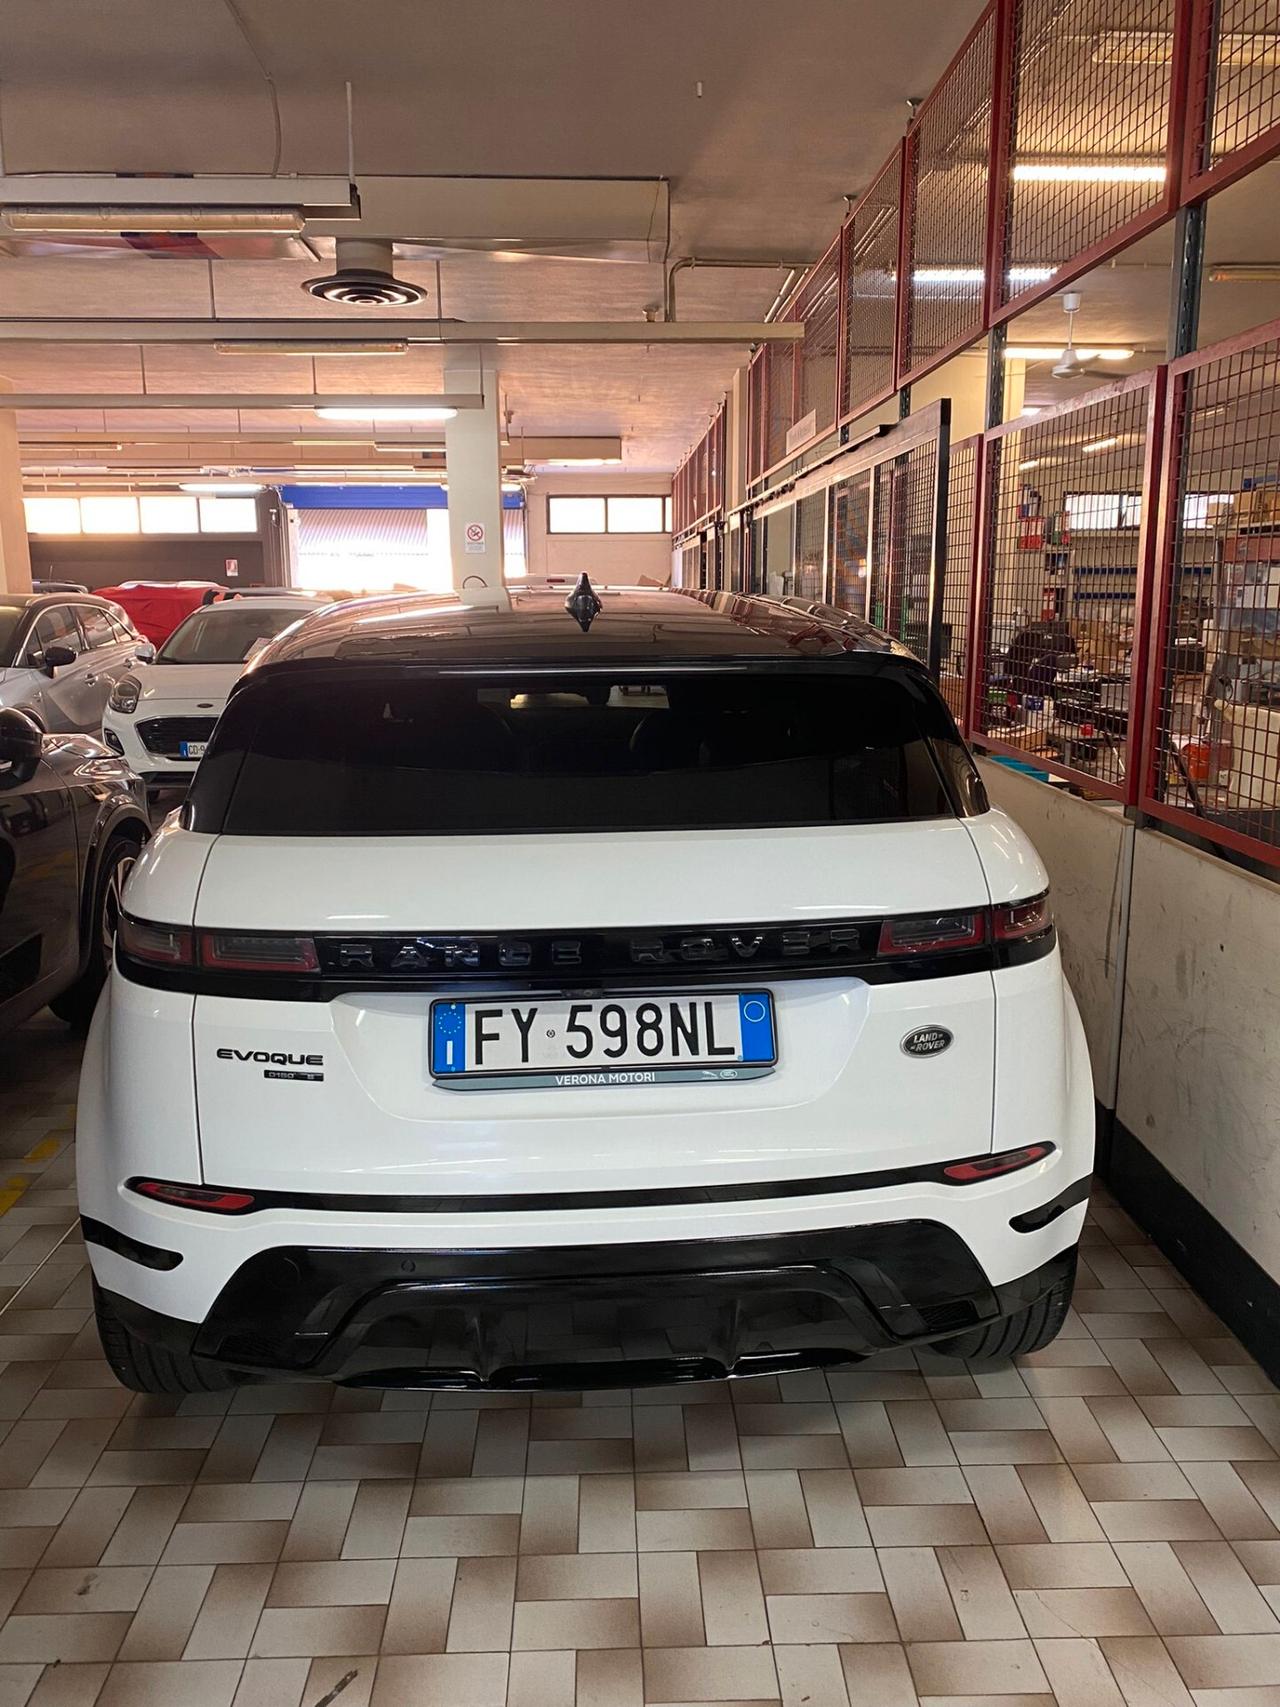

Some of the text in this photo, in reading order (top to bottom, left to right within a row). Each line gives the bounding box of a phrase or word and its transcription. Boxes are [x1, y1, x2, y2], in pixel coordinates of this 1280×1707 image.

[339, 928, 860, 967] RANGE ROVER
[475, 1002, 735, 1065] FY 598NL
[216, 1048, 324, 1065] EVOQUE
[555, 1071, 655, 1085] VERONA MOTORI
